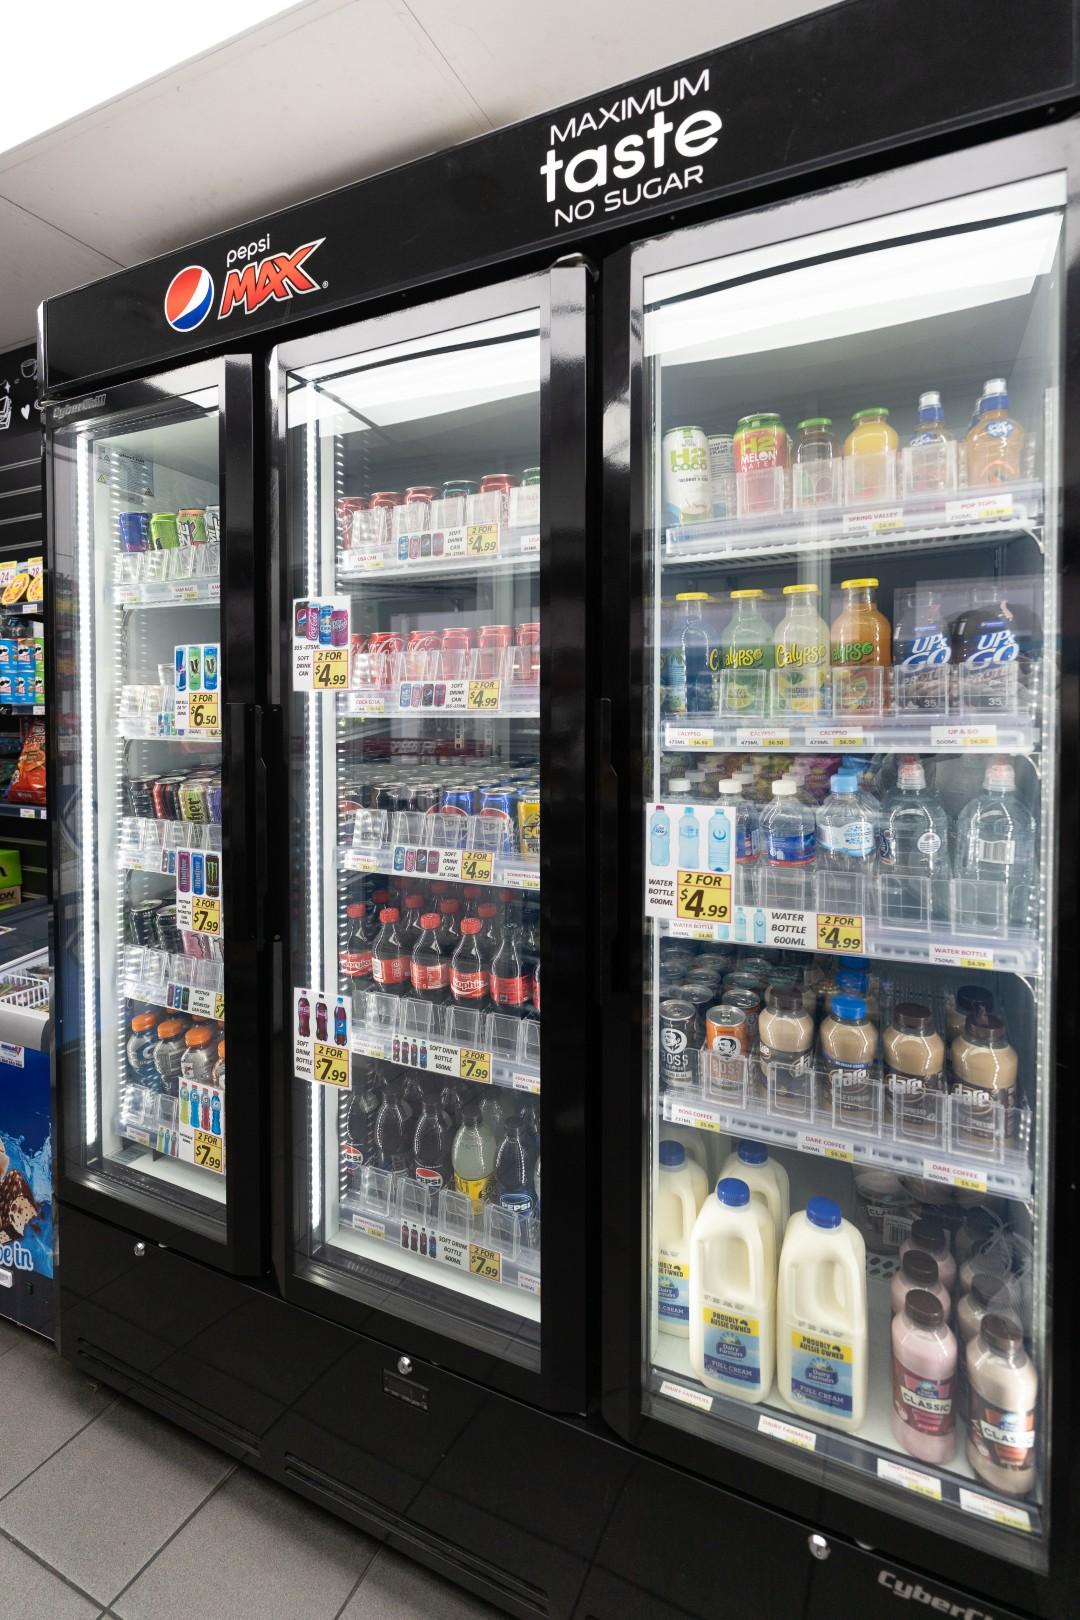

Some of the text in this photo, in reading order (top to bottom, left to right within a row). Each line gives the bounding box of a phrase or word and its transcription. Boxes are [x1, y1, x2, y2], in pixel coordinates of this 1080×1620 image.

[551, 69, 709, 145] MAXIMUM
[540, 110, 722, 202] taste
[555, 165, 704, 227] NO SUGAR
[227, 234, 270, 267] pepsi
[217, 237, 327, 320] MAX
[741, 451, 775, 464] MELON
[469, 534, 496, 552] $4.99
[325, 652, 342, 660] FOR
[776, 643, 826, 668] Calypso
[902, 646, 952, 673] GO
[965, 643, 1019, 671] GO
[315, 664, 346, 686] $4.99
[192, 694, 212, 702] 2 FOR
[470, 690, 497, 707] $4.99
[190, 705, 216, 726] $6.50
[473, 852, 487, 860] FOR
[464, 862, 490, 879] $4.99
[684, 874, 722, 886] 2 FOR
[648, 888, 675, 896] BOTTLE
[202, 900, 215, 908] FOR
[680, 888, 728, 918] $4.99
[194, 910, 218, 932] $7.99
[771, 912, 804, 922] WATER
[833, 917, 854, 926] FOR
[771, 924, 806, 934] BOTTLE
[774, 936, 806, 946] 600ML
[820, 927, 860, 949] $4.99
[961, 950, 987, 958] BOTTLE
[296, 1048, 310, 1056] DRINK
[318, 1046, 324, 1054] 2
[326, 1048, 343, 1058] FOR
[429, 1044, 442, 1053] SOFT
[296, 1057, 312, 1065] BOTTLE
[434, 1055, 453, 1063] BOTTLE
[470, 1052, 485, 1060] FOR
[316, 1058, 346, 1082] $7.99
[462, 1059, 488, 1078] $7.99
[889, 1074, 922, 1094] dare
[955, 1084, 989, 1107] dare
[198, 1132, 218, 1145] 2 FOR
[823, 1140, 846, 1150] COFFEE
[196, 1146, 220, 1168] $7.99
[952, 1169, 978, 1179] COFFEE
[438, 1236, 467, 1250] SOFT DRINK
[444, 1246, 462, 1257] BOTTLE
[481, 1248, 494, 1259] FOR
[472, 1256, 498, 1278] $7.99
[713, 1312, 738, 1324] PROUDLY
[711, 1319, 751, 1333] AUSSIE OWNED
[802, 1336, 830, 1349] PROUDLY
[800, 1344, 844, 1360] AUSSIE OWNED
[729, 1364, 752, 1376] CREAM
[817, 1390, 844, 1403] CREAM
[903, 1392, 951, 1412] CLASSIC
